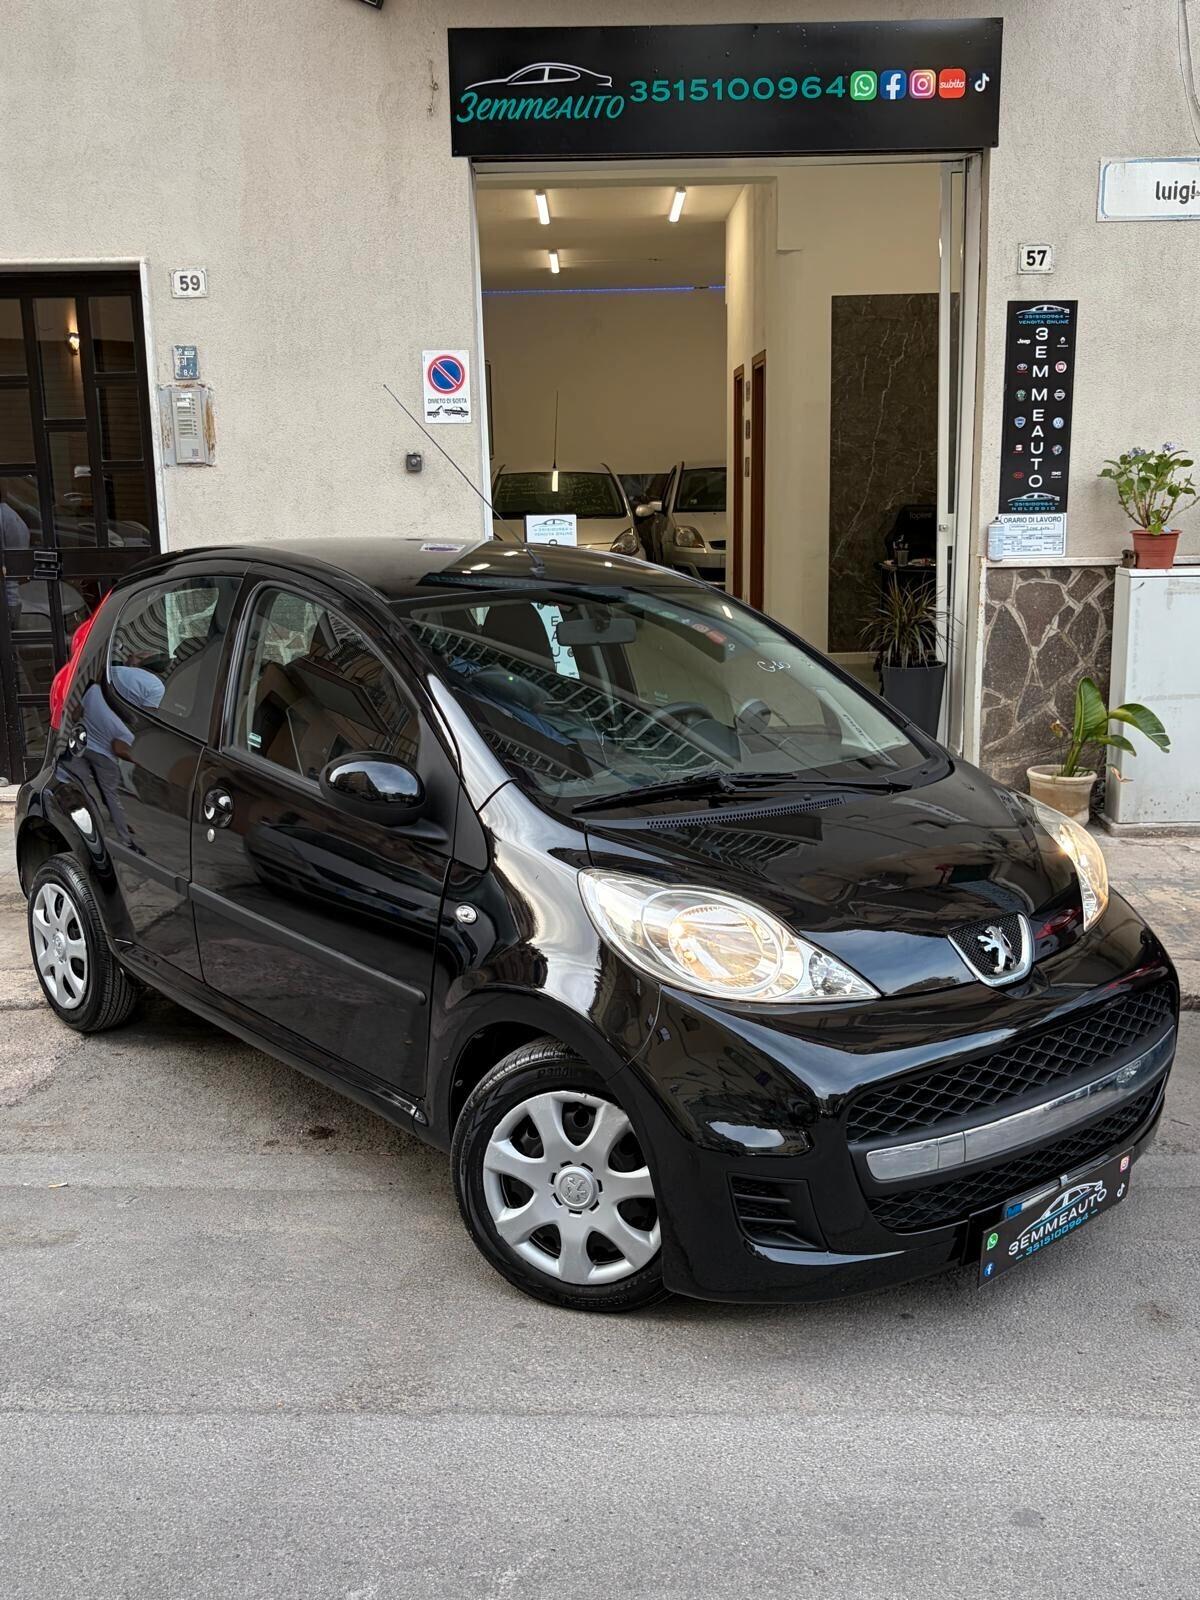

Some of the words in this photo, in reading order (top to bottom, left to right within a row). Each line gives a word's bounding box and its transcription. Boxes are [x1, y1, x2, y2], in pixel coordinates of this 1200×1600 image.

[629, 76, 845, 102] 3515100964
[940, 77, 966, 89] subito
[1155, 179, 1197, 205] luigi
[1026, 249, 1047, 267] 57
[179, 274, 201, 292] 59
[1026, 1212, 1089, 1256] 3515100964
